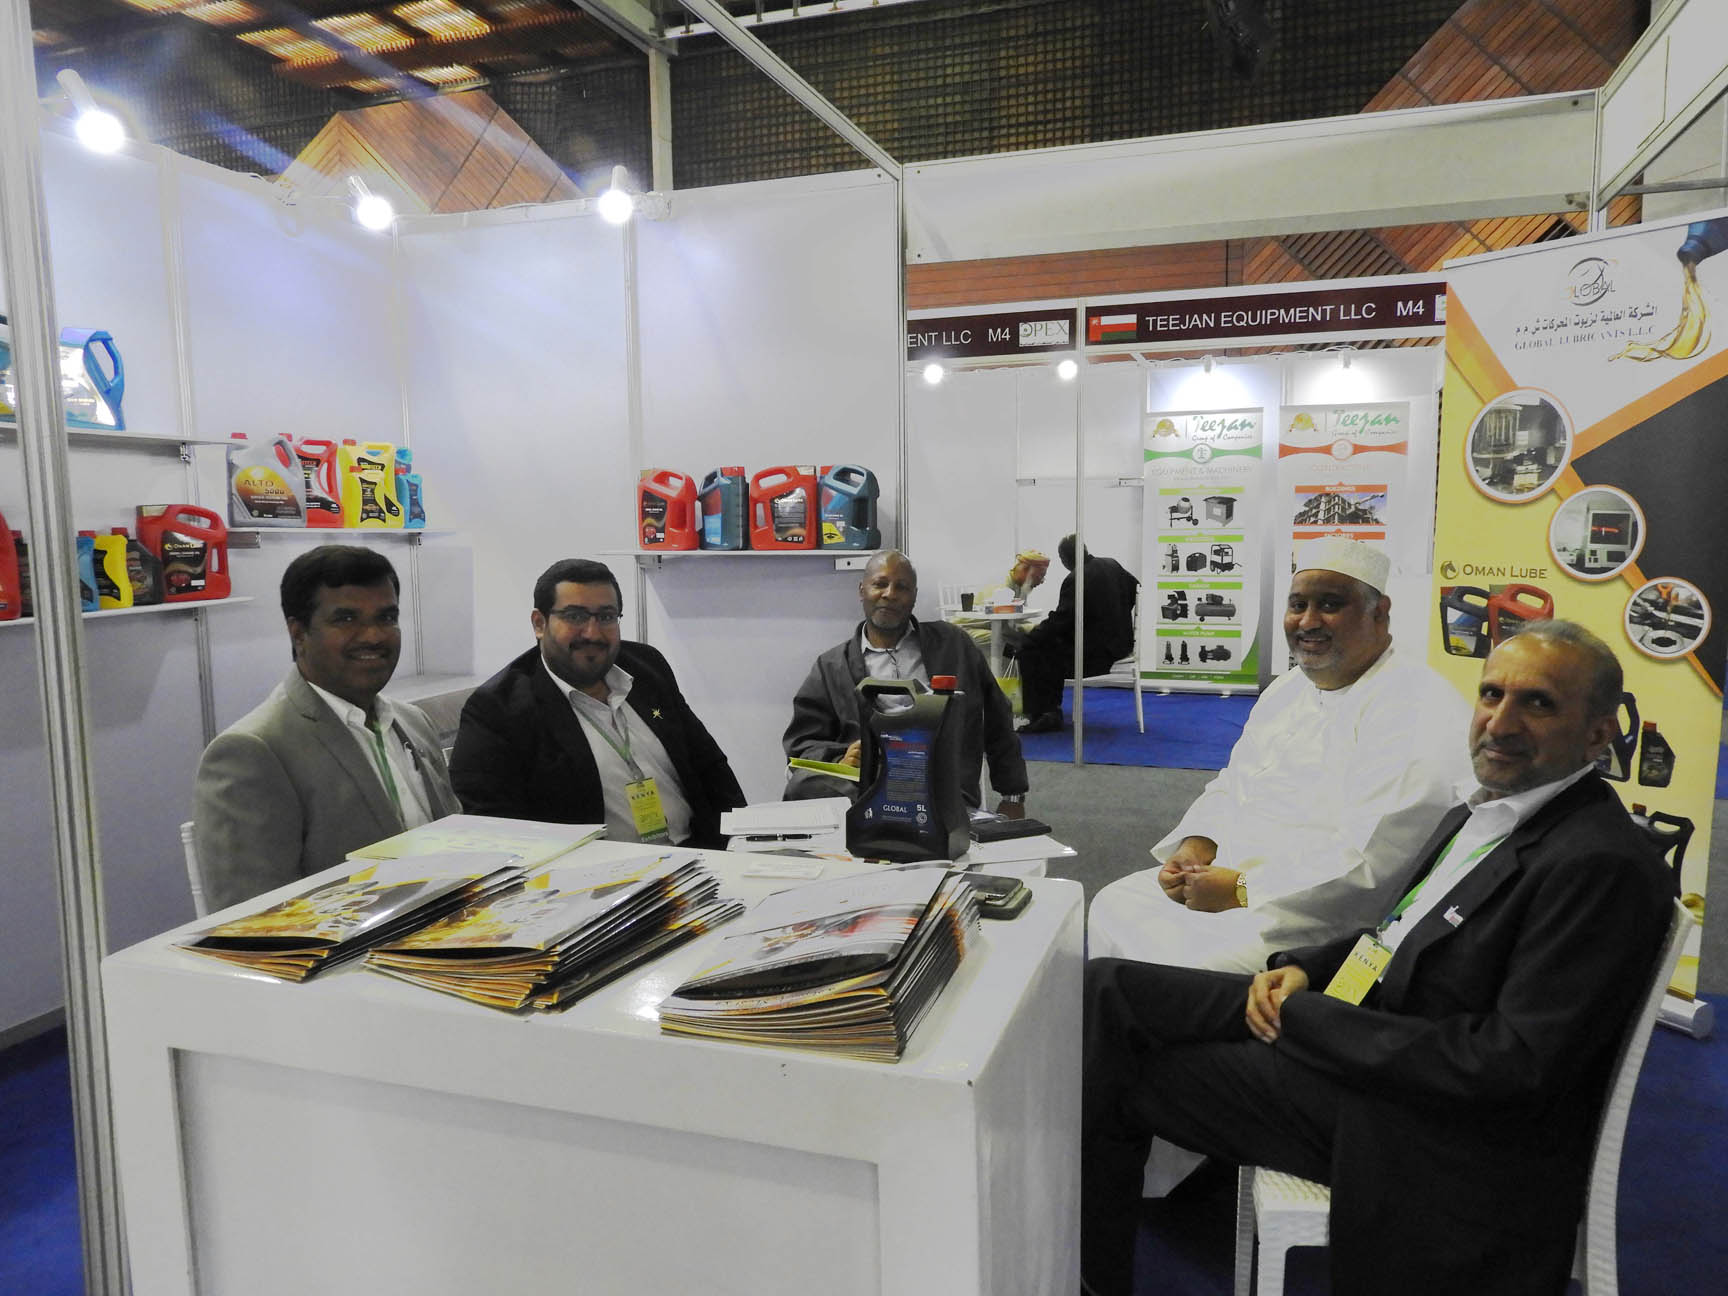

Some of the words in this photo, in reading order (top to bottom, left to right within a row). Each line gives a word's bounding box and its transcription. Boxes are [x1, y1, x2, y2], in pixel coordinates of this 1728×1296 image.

[1145, 313, 1215, 332] TEEJAN
[1220, 305, 1335, 328] EQUIPMENT
[1339, 302, 1376, 320] LLC
[1396, 299, 1425, 317] M4
[942, 329, 972, 345] LLC
[988, 327, 1011, 343] M4
[244, 479, 274, 488] ALTO
[1462, 563, 1506, 577] OMAN
[1510, 566, 1548, 579] LUBE
[882, 804, 908, 814] GLOBAL
[916, 804, 927, 812] 5L
[1353, 951, 1379, 973] KENYA
